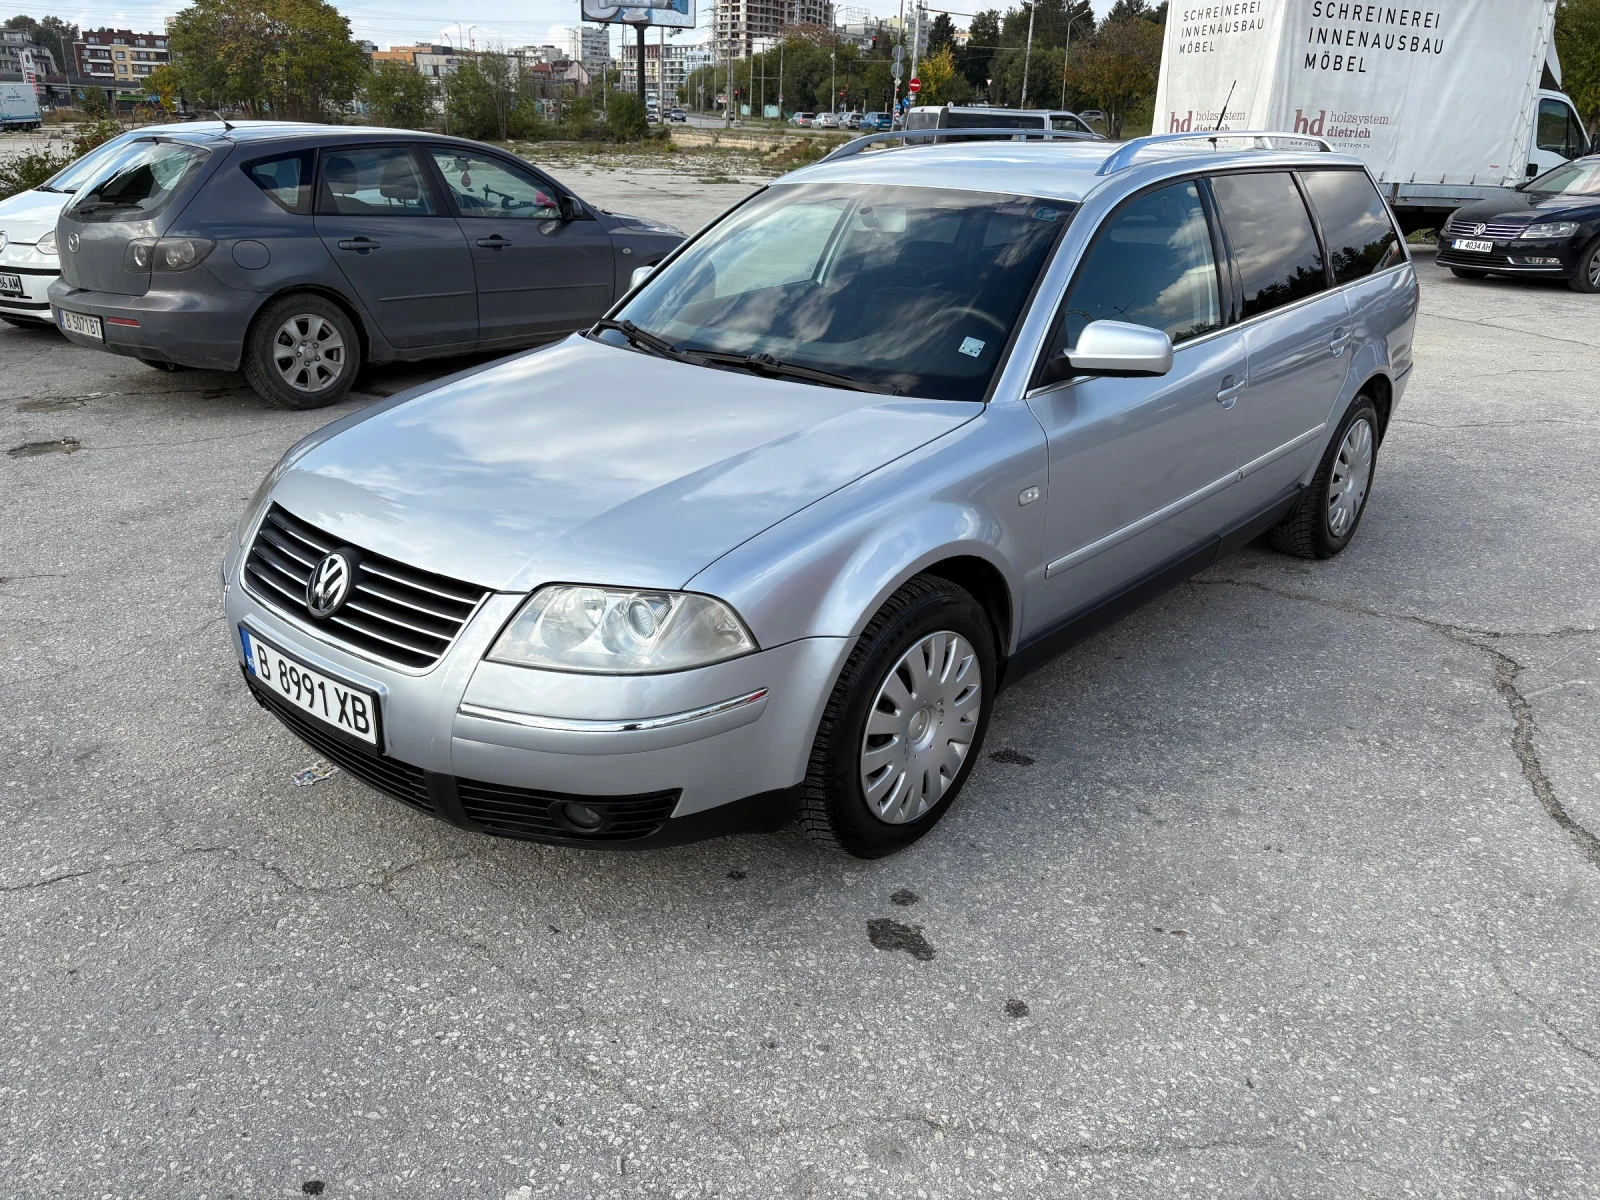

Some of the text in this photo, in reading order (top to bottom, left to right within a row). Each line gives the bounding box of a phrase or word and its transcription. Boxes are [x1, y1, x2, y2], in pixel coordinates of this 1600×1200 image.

[1183, 1, 1261, 22] SCHREINEREI
[1312, 0, 1440, 29] SCHREINEREI
[1181, 18, 1264, 38] INNENAUSBAU
[1179, 41, 1215, 54] MÖBEL
[1308, 26, 1444, 55] INNENAUSBAU
[1304, 50, 1366, 73] MÖBEL
[1169, 110, 1193, 134] hd
[1293, 108, 1326, 137] hd
[1329, 111, 1389, 126] holzsystem
[1327, 125, 1371, 139] dietrich
[1459, 240, 1464, 249] T
[1465, 241, 1481, 250] 4034
[66, 313, 71, 328] B
[257, 643, 370, 734] B 8991 XB
